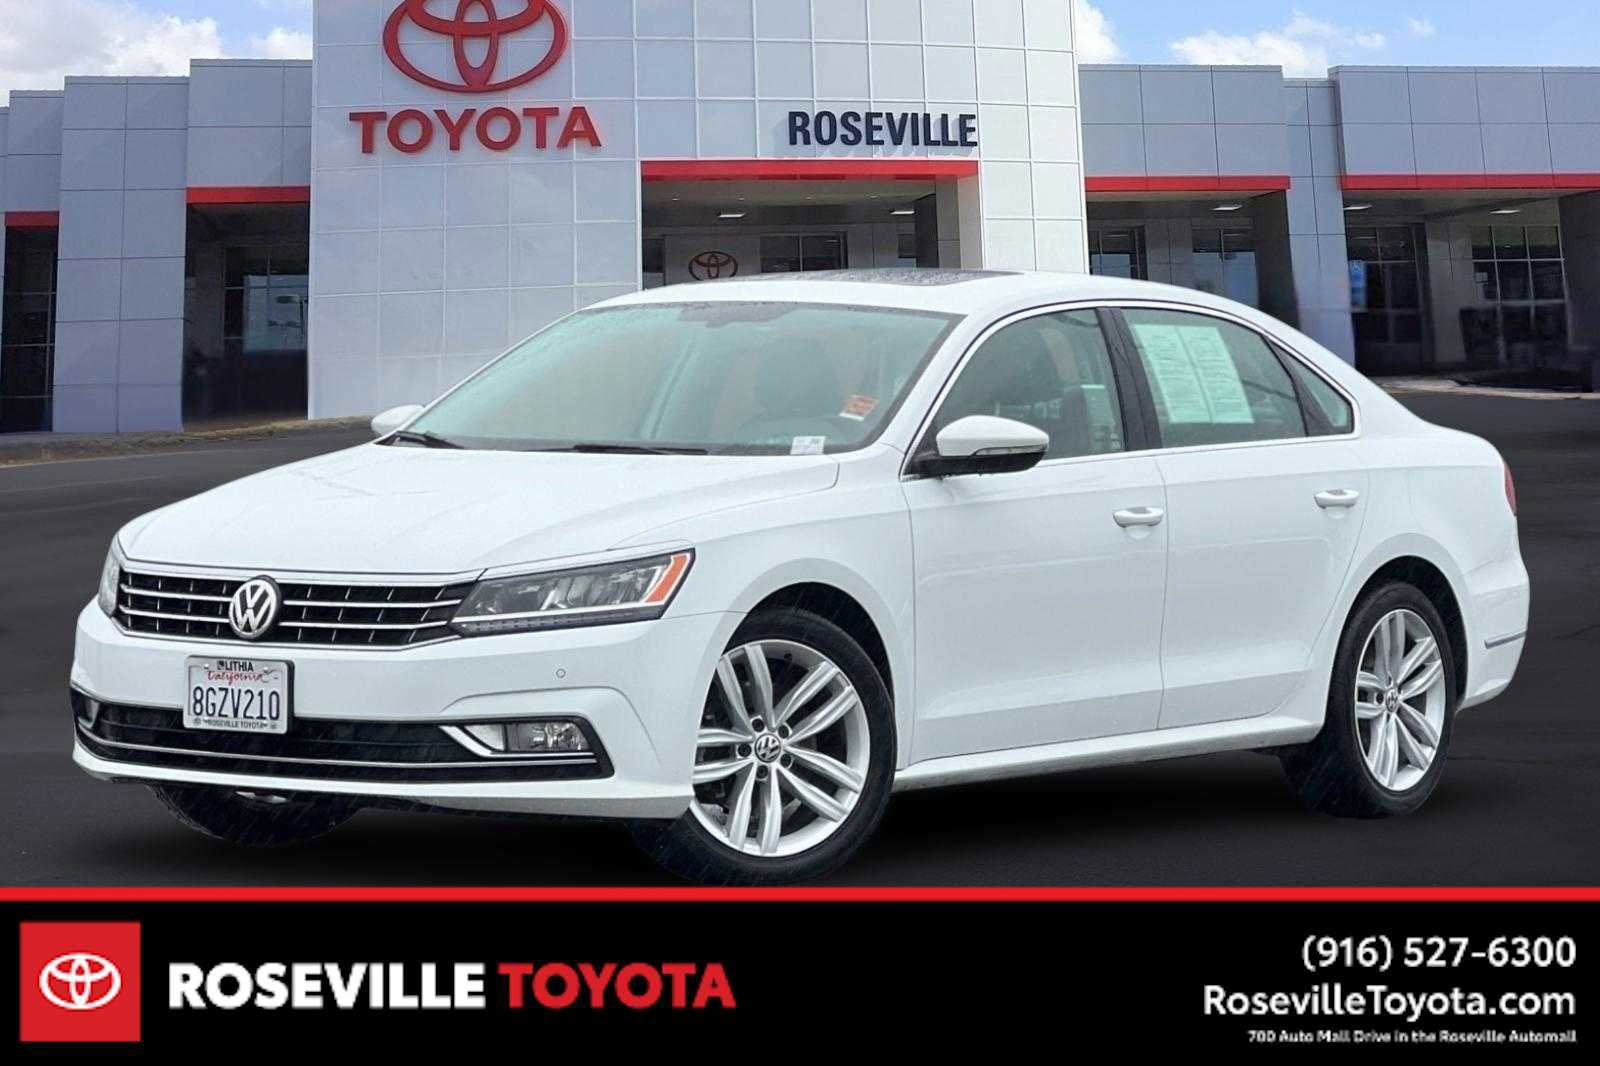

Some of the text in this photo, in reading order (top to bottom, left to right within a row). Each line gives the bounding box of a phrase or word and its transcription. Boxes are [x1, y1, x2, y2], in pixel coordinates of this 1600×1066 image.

[349, 106, 602, 154] TOYOTA
[788, 111, 978, 147] ROSEVILLE
[225, 660, 254, 672] LITHIA
[192, 686, 280, 720] 8GZV210
